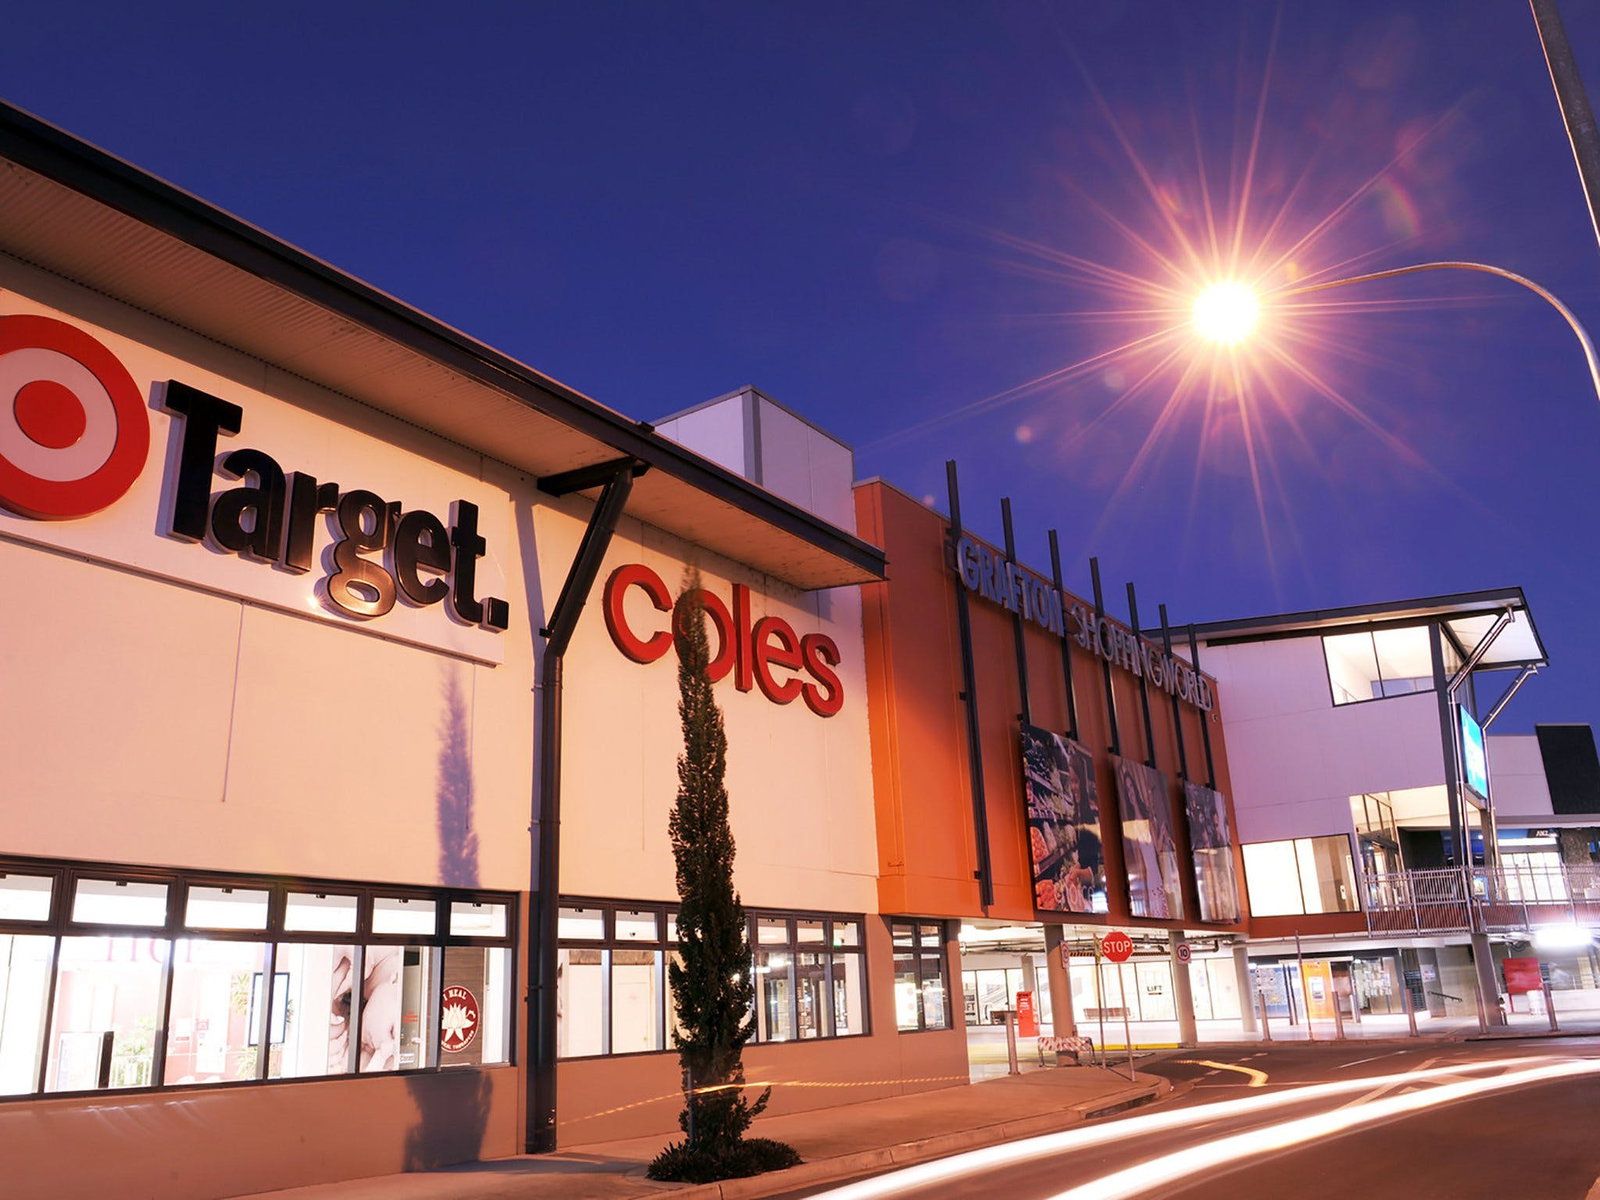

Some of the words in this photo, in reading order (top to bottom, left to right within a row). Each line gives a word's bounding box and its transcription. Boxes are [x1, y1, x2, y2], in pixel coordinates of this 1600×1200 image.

[165, 378, 509, 632] Target.
[603, 563, 845, 717] coles
[956, 536, 1064, 637] GRAFTON
[1070, 603, 1213, 711] SHOPPINGWORLD
[1103, 940, 1131, 954] STOP
[1179, 948, 1188, 957] 10
